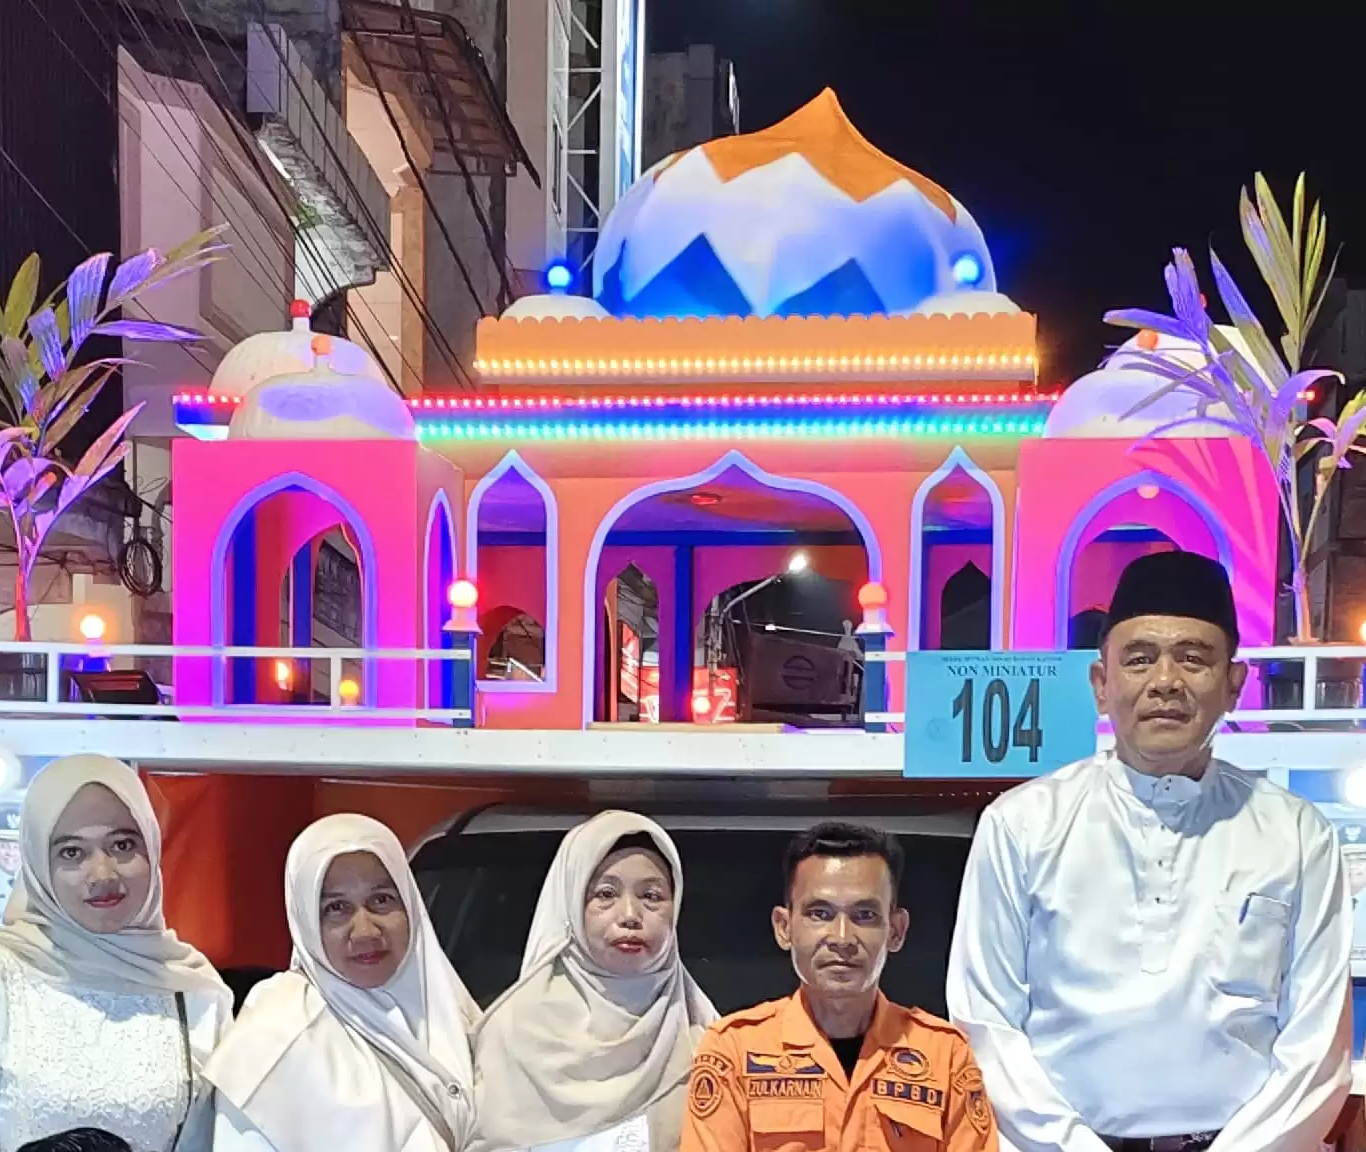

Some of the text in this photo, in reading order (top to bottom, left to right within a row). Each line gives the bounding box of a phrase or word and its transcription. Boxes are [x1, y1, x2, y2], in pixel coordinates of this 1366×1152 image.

[947, 665, 1057, 677] NON MINIATUR
[952, 678, 1043, 763] 104
[877, 1081, 936, 1105] BPBD
